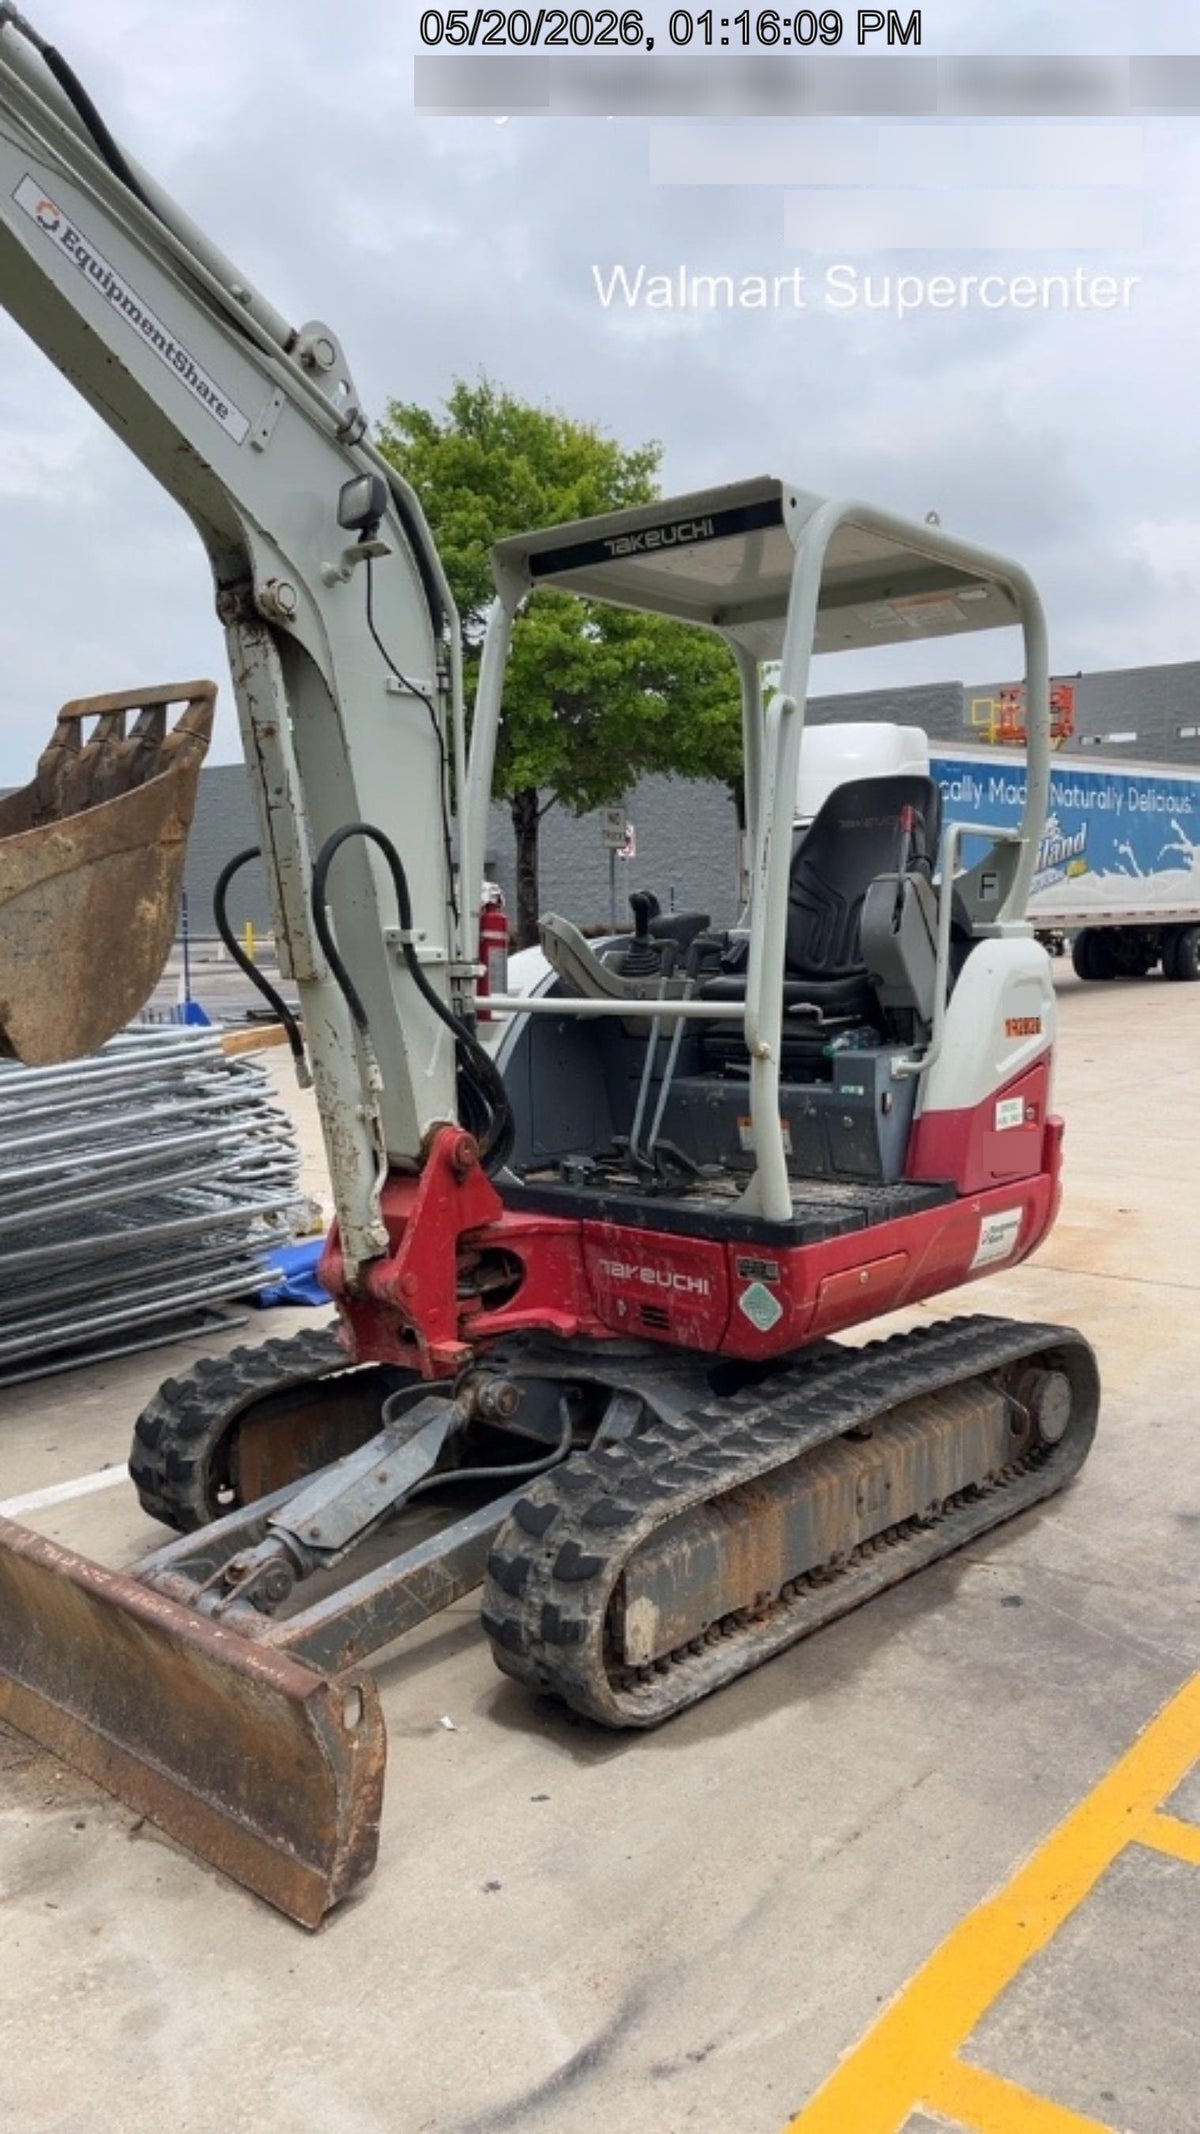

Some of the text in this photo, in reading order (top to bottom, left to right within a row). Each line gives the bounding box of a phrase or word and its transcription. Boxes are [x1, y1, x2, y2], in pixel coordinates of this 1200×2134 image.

[60, 223, 229, 421] EquipmentShare
[939, 774, 983, 810] cally
[1049, 781, 1124, 817] Naturally
[979, 871, 997, 900] F
